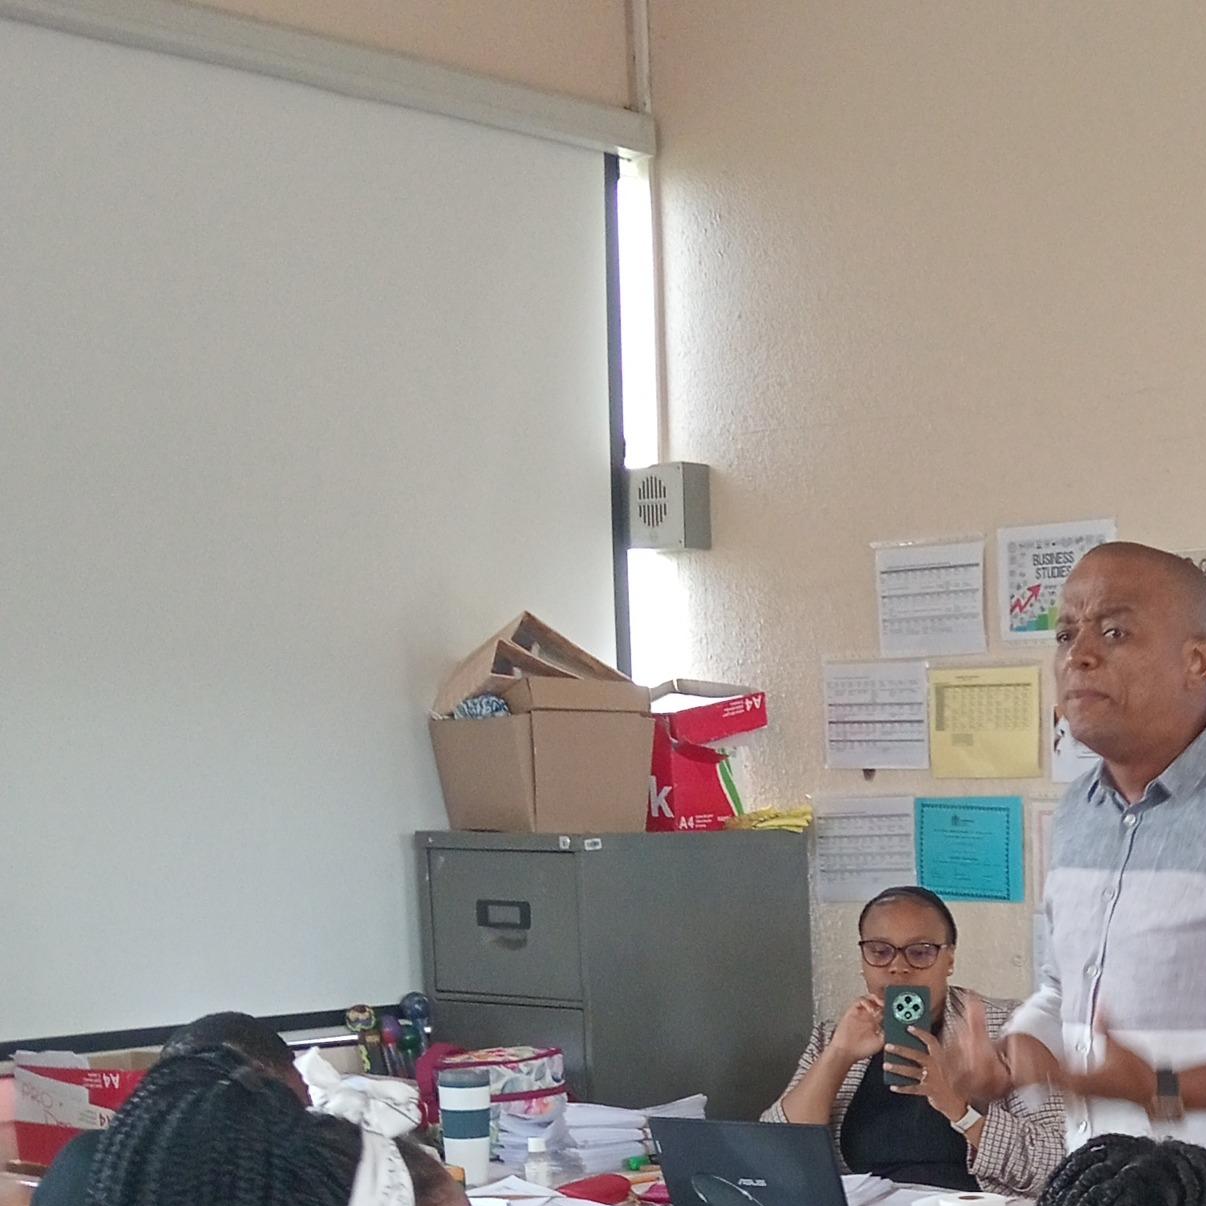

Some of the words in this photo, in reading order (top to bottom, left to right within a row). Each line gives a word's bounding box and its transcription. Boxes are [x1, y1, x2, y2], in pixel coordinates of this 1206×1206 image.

[1032, 551, 1074, 566] BUSINESS
[744, 695, 762, 711] A4
[679, 816, 694, 830] A4
[102, 1072, 120, 1089] A4
